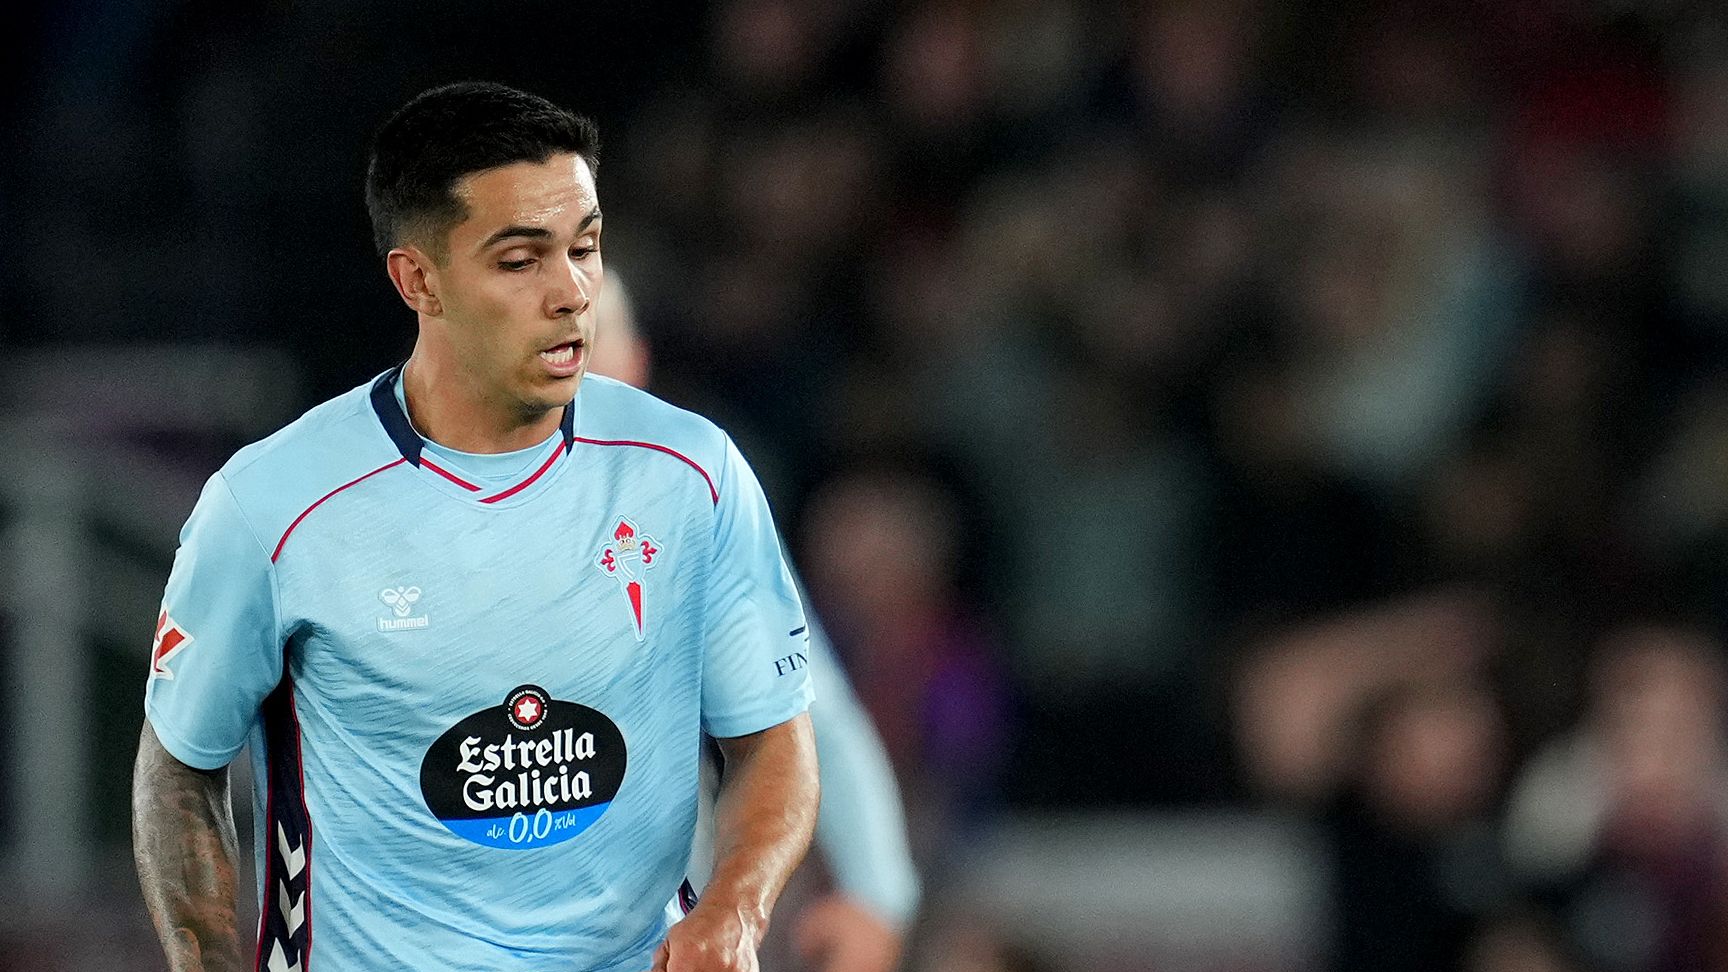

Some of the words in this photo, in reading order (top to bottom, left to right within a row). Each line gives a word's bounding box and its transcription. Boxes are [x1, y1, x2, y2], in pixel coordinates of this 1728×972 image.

[379, 614, 429, 630] hummel
[456, 727, 596, 773] Estrella
[462, 764, 593, 812] Galicia
[508, 807, 553, 844] 0,0
